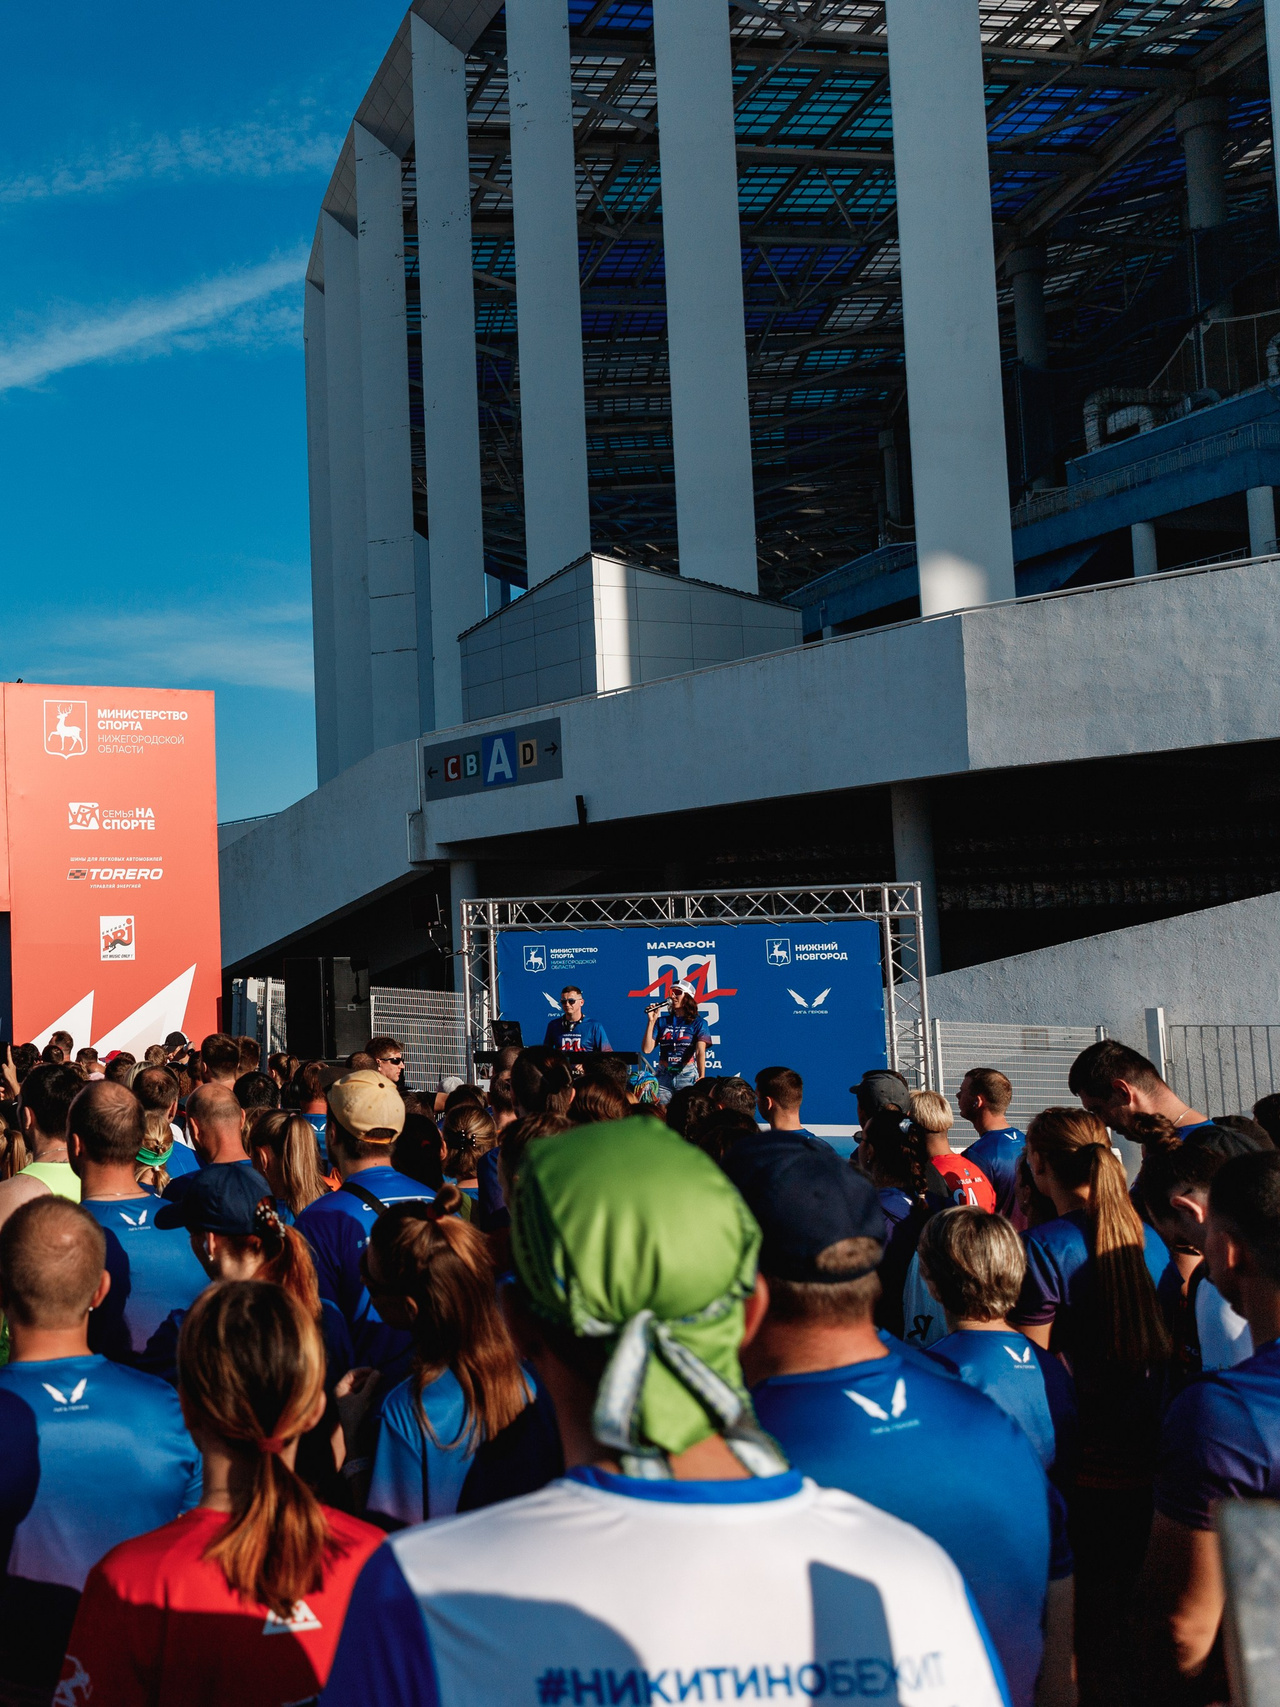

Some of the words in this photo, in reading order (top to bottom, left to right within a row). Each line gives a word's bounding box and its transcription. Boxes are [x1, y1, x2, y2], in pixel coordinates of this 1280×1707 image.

[97, 709, 188, 721] МИНИСТЕРСТВО
[97, 720, 143, 731] СПОРТА
[97, 734, 185, 745] НИЖЕГОРОДСКОЙ
[97, 745, 144, 754] ОБЛАСТИ
[447, 757, 458, 779] C
[466, 754, 478, 776] B
[487, 738, 513, 783] A
[522, 743, 534, 765] D
[102, 810, 134, 818] СЕМЬЯ
[135, 807, 155, 818] НА
[102, 819, 155, 830] СПОРТЕ
[89, 868, 163, 880] TORERO
[646, 940, 716, 950] МАРАФОН
[795, 942, 838, 951] НИЖНИЙ
[795, 952, 848, 961] НОВГОРОД
[534, 1651, 946, 1707] #НИКИТИНОБЕЖИТ
